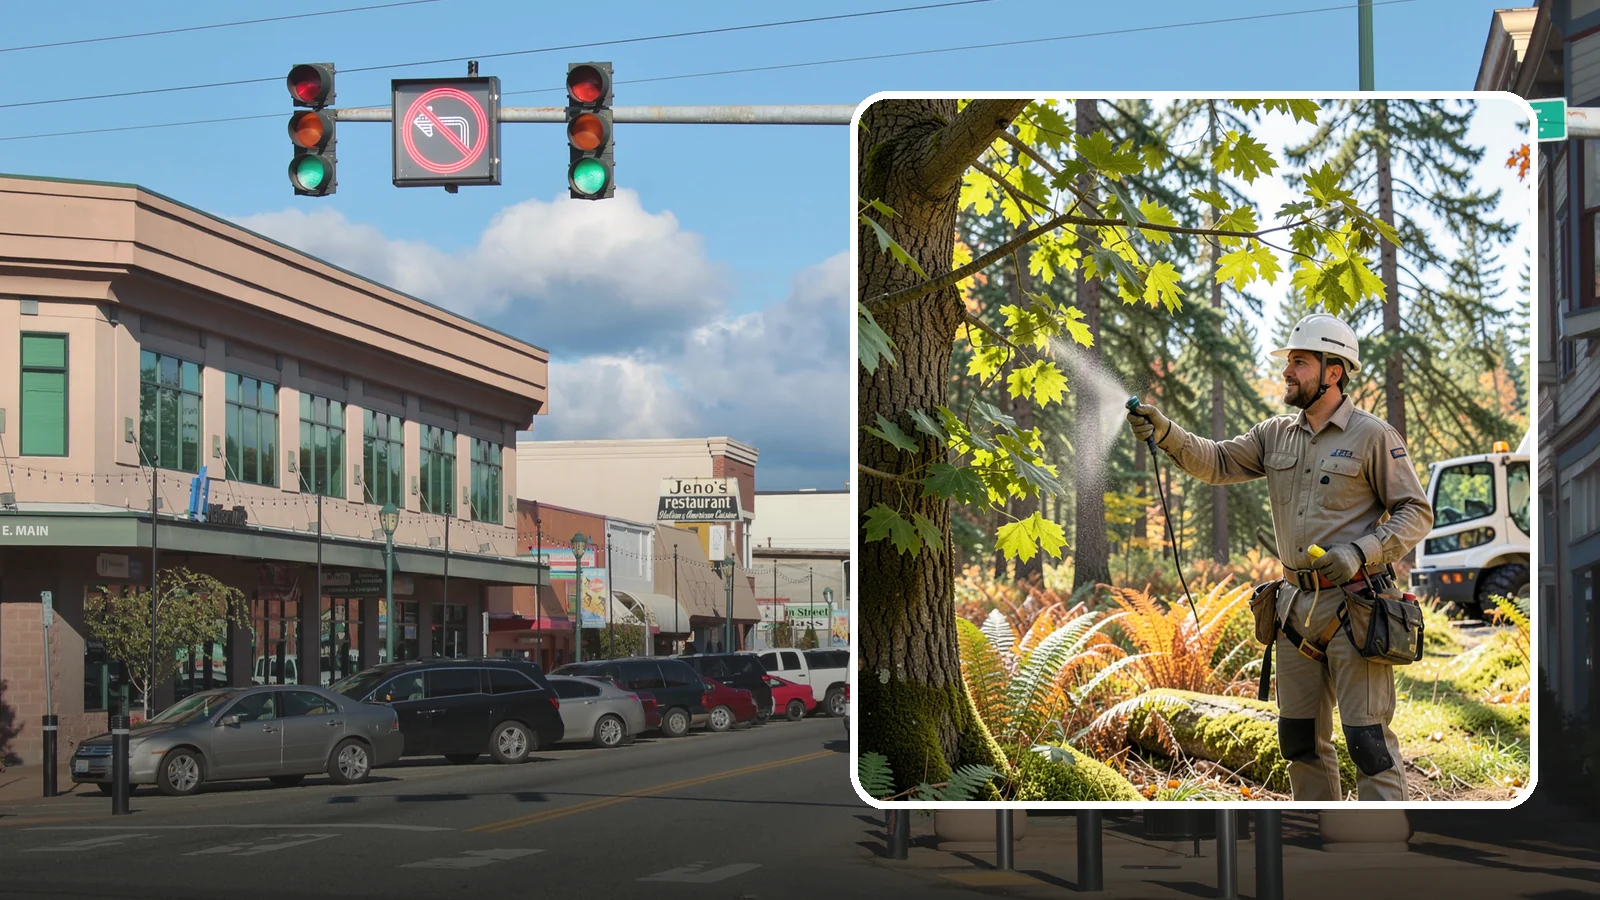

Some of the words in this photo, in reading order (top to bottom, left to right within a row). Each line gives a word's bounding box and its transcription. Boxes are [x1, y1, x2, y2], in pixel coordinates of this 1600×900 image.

[670, 480, 728, 494] Jeno's
[665, 496, 731, 509] restaurant
[659, 510, 681, 519] Italian
[686, 510, 714, 519] American
[715, 509, 737, 519] Cuisine
[2, 525, 13, 536] E.
[16, 525, 49, 536] MAIN
[797, 607, 828, 616] Street
[791, 619, 823, 627] lass
